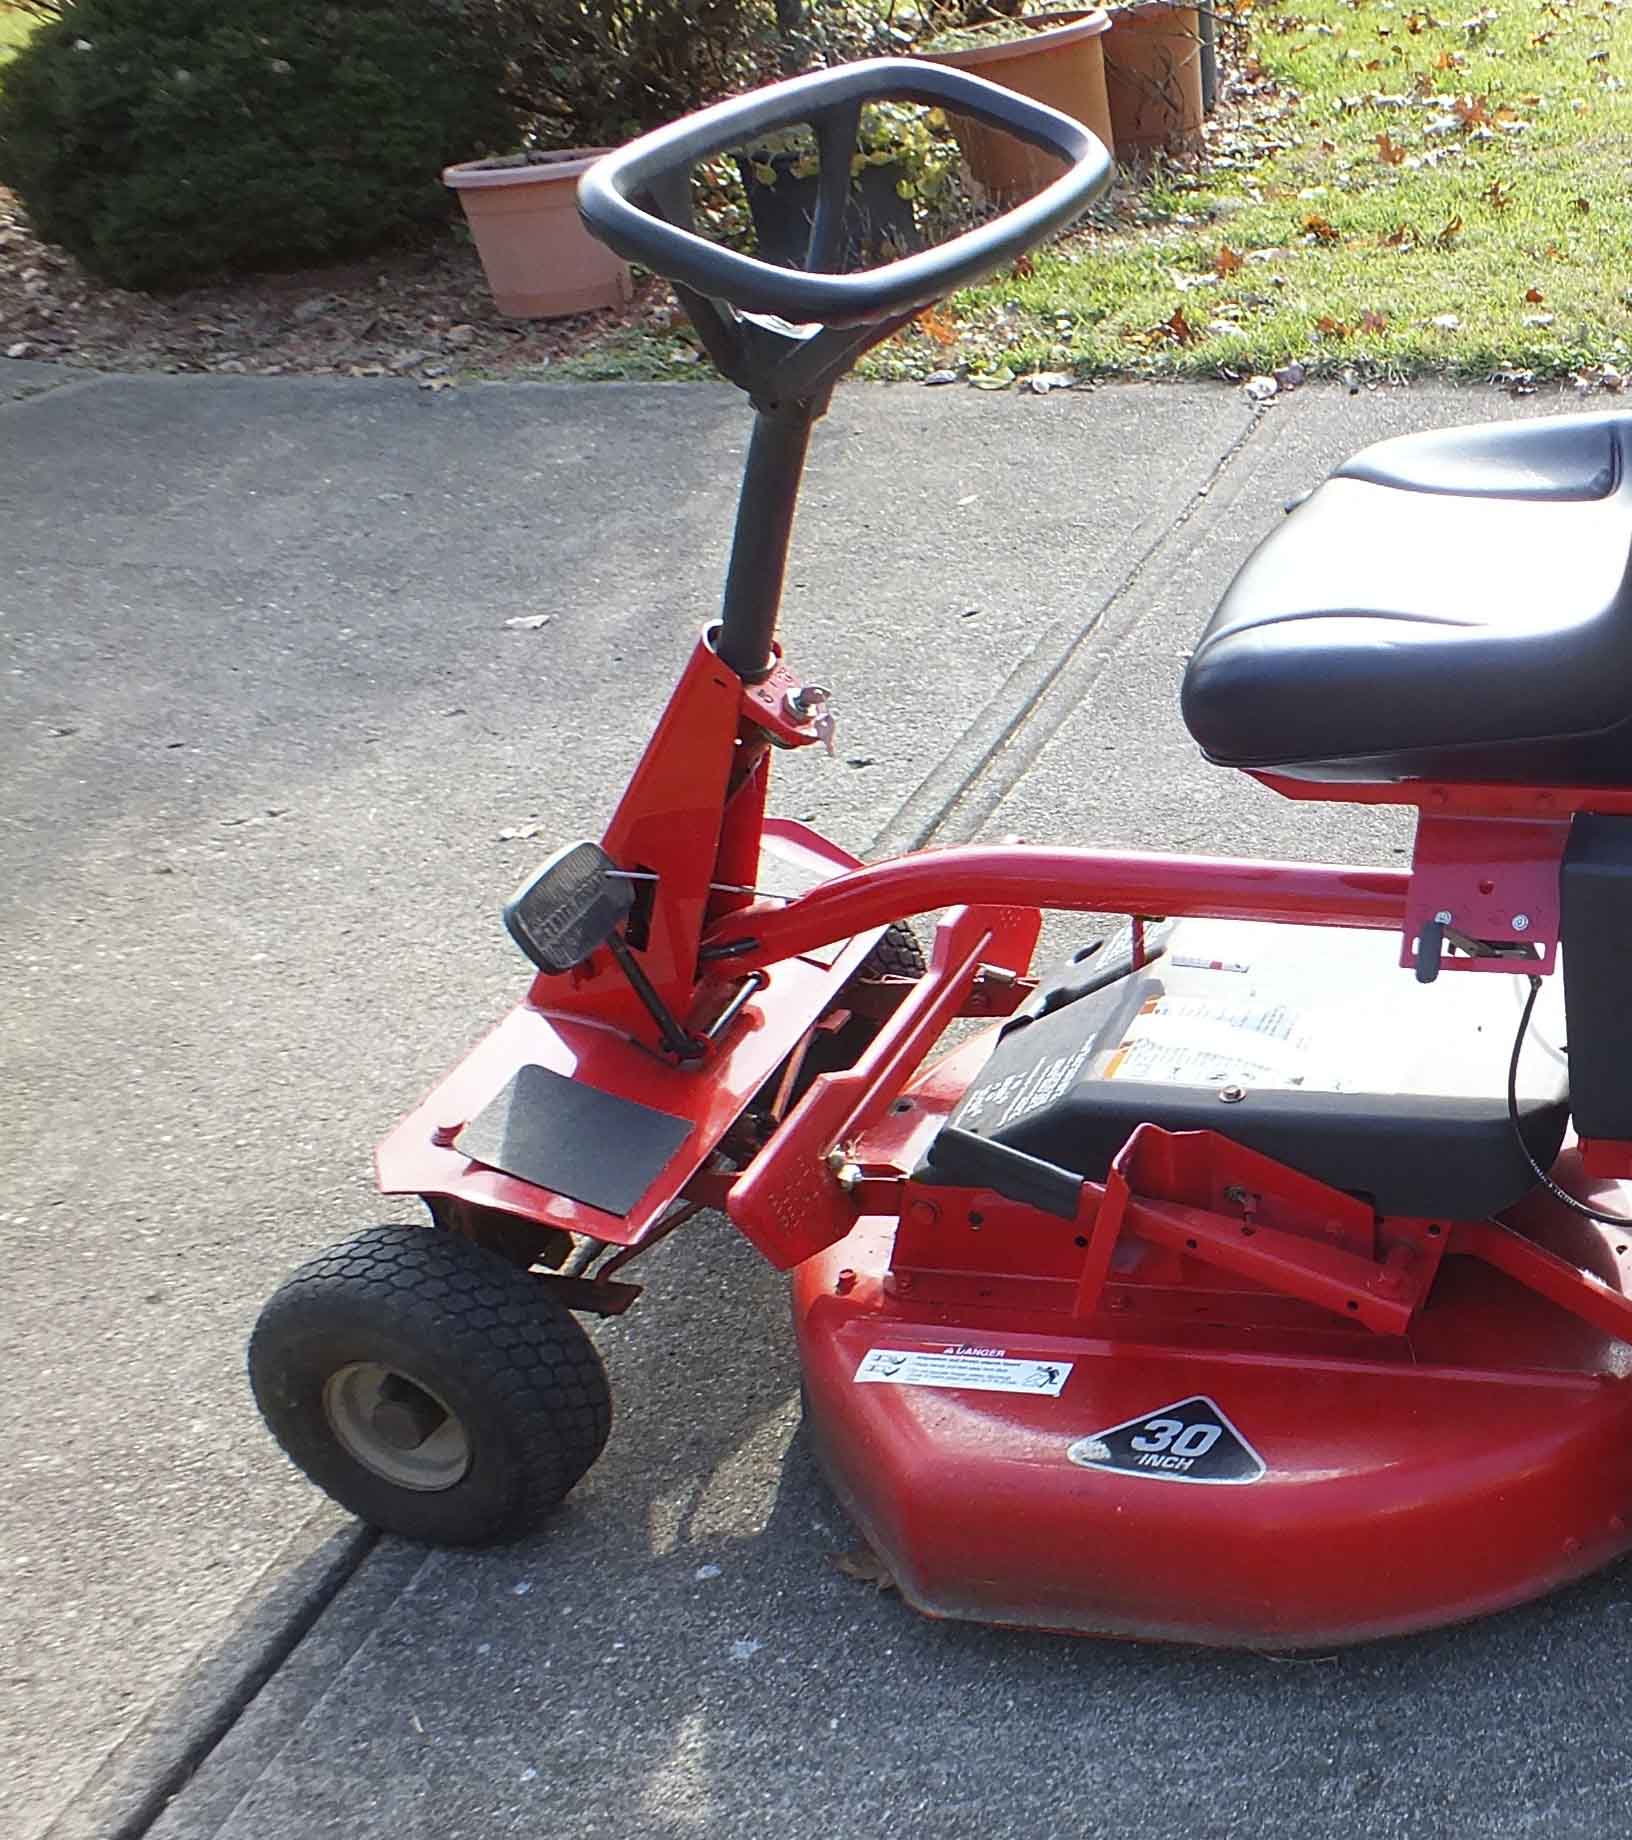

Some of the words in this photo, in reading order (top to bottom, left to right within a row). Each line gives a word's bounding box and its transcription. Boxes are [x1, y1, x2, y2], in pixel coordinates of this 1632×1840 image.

[956, 1346, 1007, 1358] DANGER
[1131, 1419, 1222, 1457] 30
[1138, 1453, 1195, 1470] INCH
